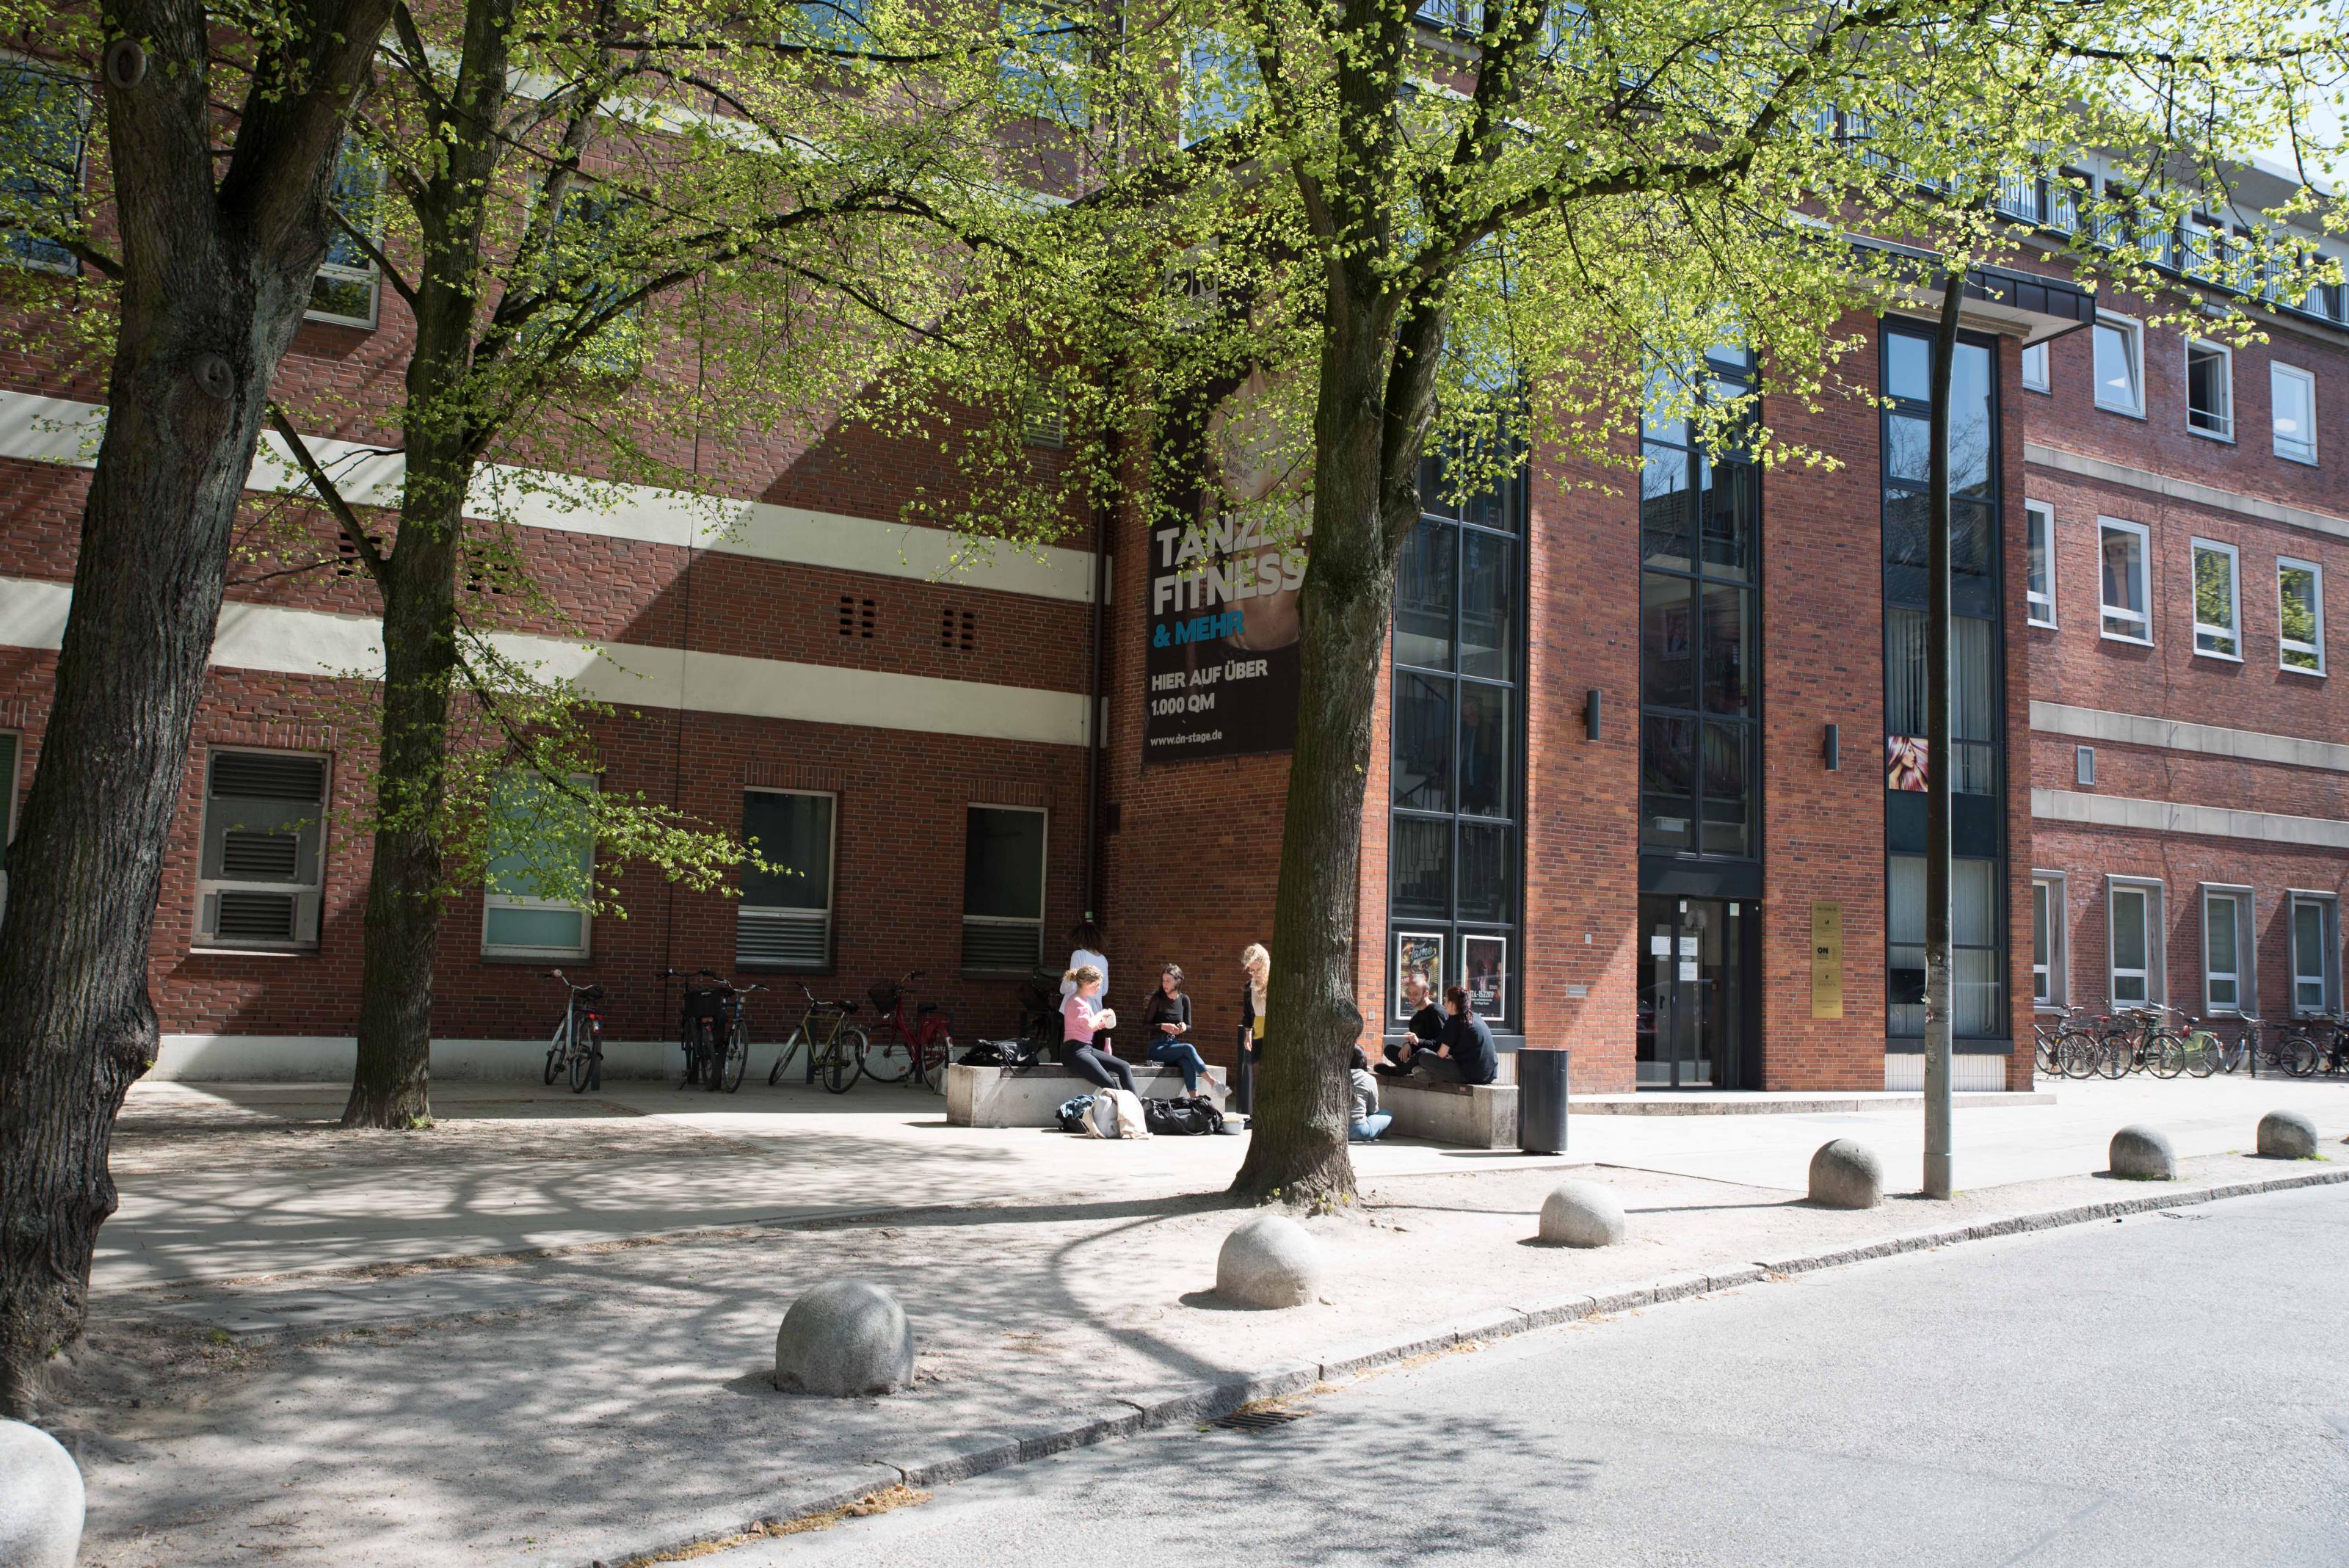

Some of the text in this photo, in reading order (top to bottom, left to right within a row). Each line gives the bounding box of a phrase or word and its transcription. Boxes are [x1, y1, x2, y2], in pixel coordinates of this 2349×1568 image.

[1153, 548, 1307, 615] FITNESS
[1153, 610, 1246, 648] & MEHR
[1152, 659, 1268, 692] HIER AUF ÜBER
[1151, 693, 1215, 716] 1.000 QM
[1150, 729, 1222, 747] www.on-stage.de
